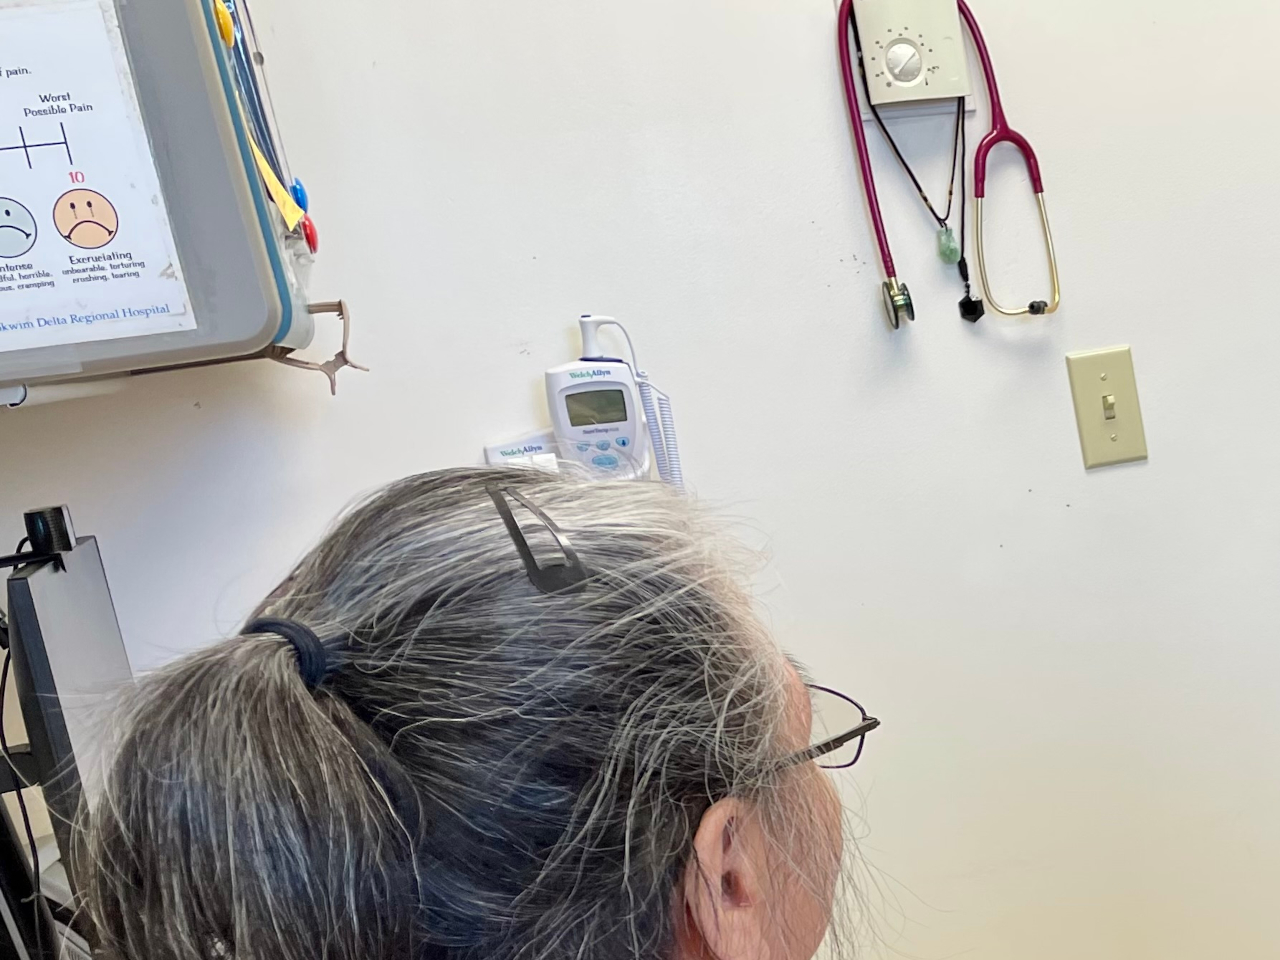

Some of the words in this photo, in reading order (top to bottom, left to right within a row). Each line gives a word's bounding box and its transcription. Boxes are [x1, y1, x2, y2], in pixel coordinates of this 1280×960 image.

[5, 66, 32, 79] pain.
[39, 92, 71, 103] Worst
[23, 104, 67, 117] Possible
[69, 103, 93, 113] Pain
[68, 171, 85, 183] 10
[69, 252, 133, 265] Excruciating
[0, 263, 33, 273] ntense
[110, 261, 146, 270] torturing
[112, 270, 140, 280] tearing
[17, 280, 55, 291] cramping
[0, 319, 34, 332] kwim
[37, 317, 67, 328] Delta
[70, 309, 120, 325] Regional
[122, 303, 171, 319] Hospital
